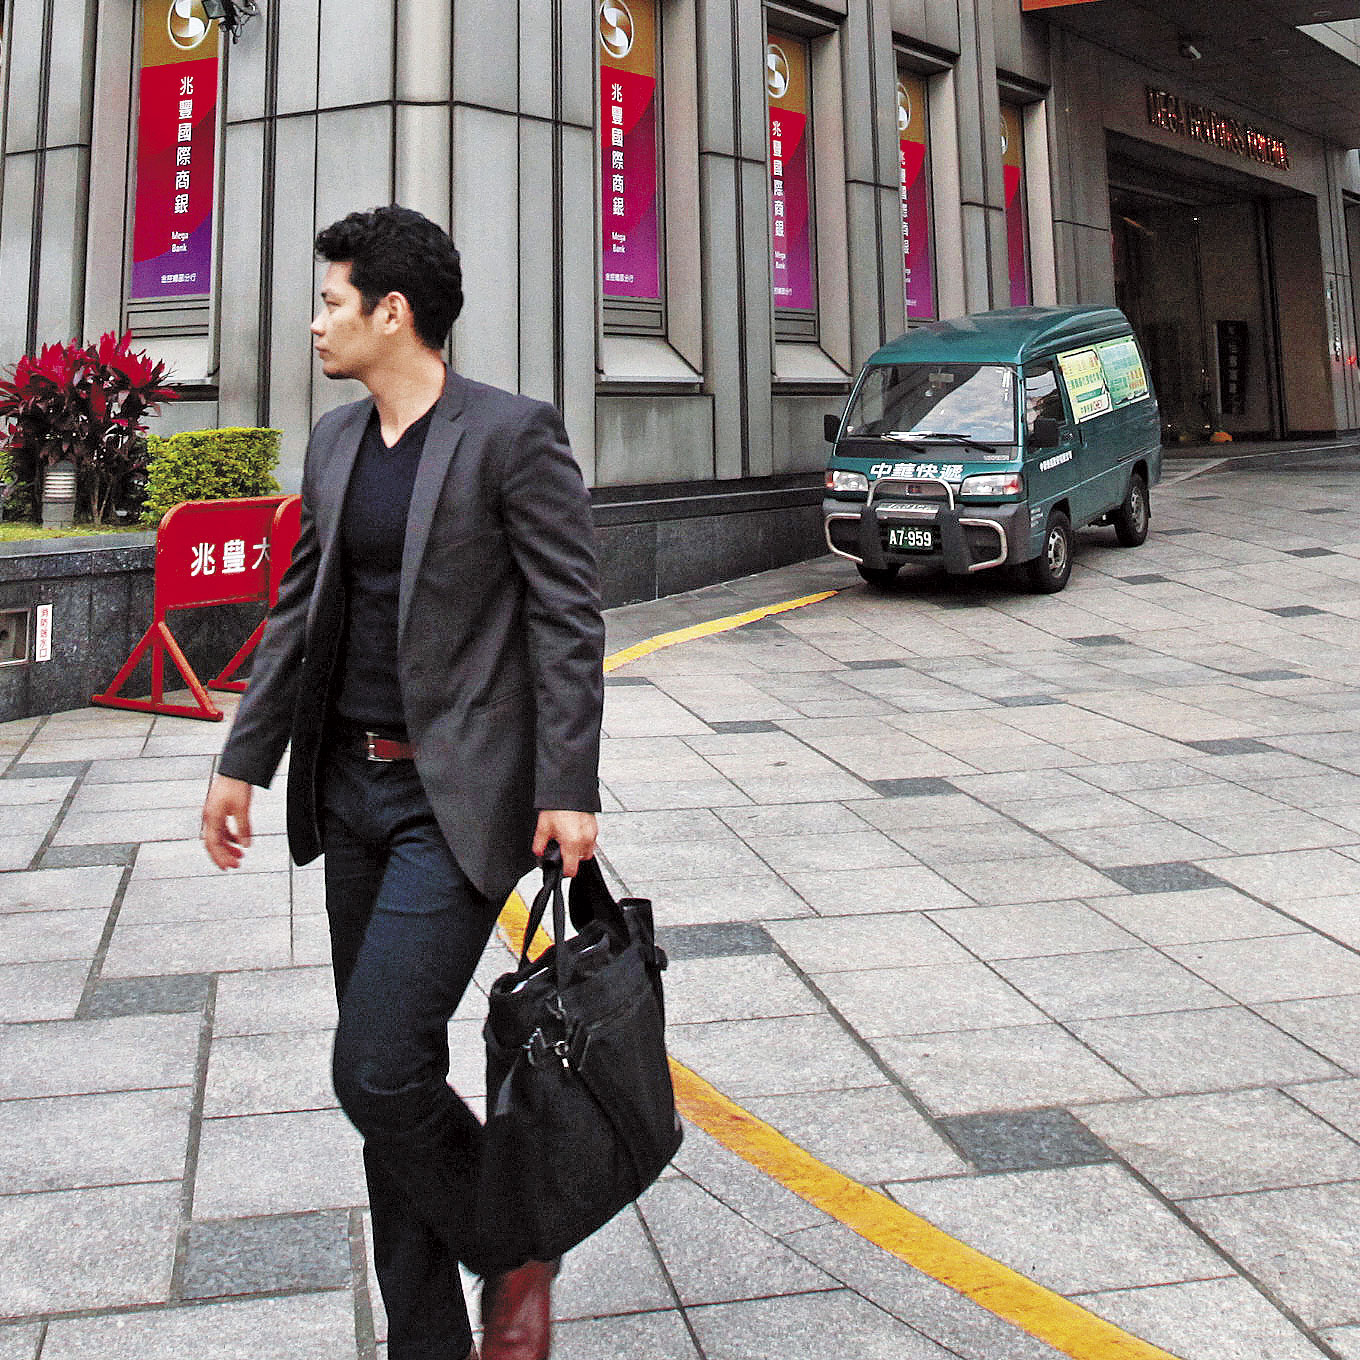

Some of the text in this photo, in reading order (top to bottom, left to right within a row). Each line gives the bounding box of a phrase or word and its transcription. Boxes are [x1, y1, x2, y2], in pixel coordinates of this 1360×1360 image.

[174, 75, 194, 214] 兆豐國際商銀
[611, 83, 625, 217] 兆豐國際商銀
[870, 462, 964, 481] 中華快遞
[889, 529, 932, 547] A7-959
